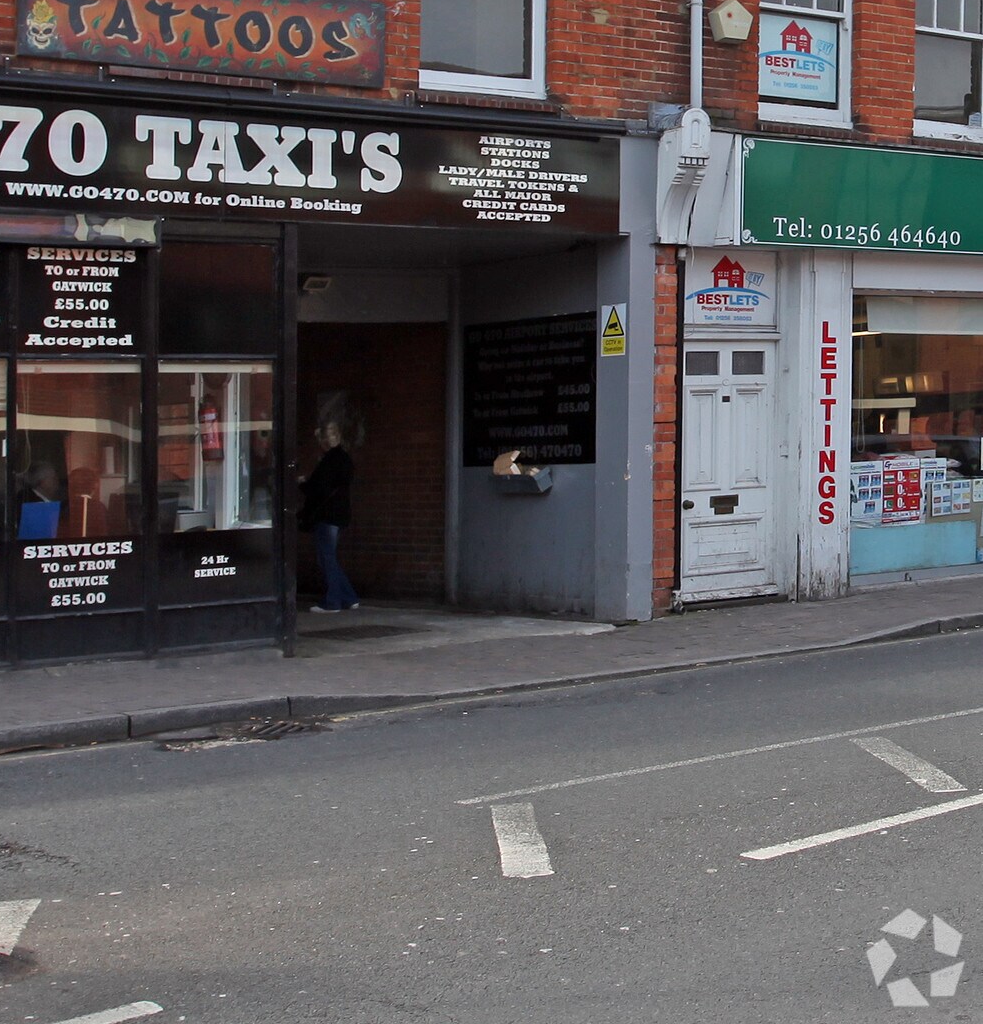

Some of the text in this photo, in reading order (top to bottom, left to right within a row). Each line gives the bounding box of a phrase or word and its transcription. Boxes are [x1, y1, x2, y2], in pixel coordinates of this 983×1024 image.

[765, 55, 825, 72] BESTLETS
[478, 135, 552, 150] AIRPORTS
[134, 113, 403, 194] TAXI'S
[480, 146, 550, 160] STATIONS
[490, 157, 541, 170] DOCKS
[438, 165, 588, 183] LADY/MALE DRIVERS
[448, 176, 579, 193] TRAVEL TOKENS &
[5, 181, 190, 204] WWW.GO470.COM
[194, 192, 222, 206] for
[225, 193, 286, 209] Online
[290, 197, 363, 215] Booking
[472, 187, 553, 202] ALL MAJOR
[462, 199, 566, 213] CREDIT CARDS
[476, 210, 552, 223] ACCEPTED
[772, 217, 961, 249] Tel: 01256 464640
[27, 246, 137, 263] SERVICES
[44, 264, 120, 277] TO or FROM
[51, 280, 113, 293] GATWICK
[54, 297, 110, 311] £55.00
[697, 293, 760, 306] BESTLETS
[43, 315, 118, 330] Credit
[24, 332, 134, 349] Accepted
[818, 321, 837, 525] LETTINGS
[23, 540, 133, 560] SERVICES
[40, 559, 116, 575] TO or FROM
[200, 554, 230, 565] 24 Hr
[194, 566, 237, 578] SERVICE
[48, 574, 109, 589] GATWICK
[50, 591, 106, 607] £55.00
